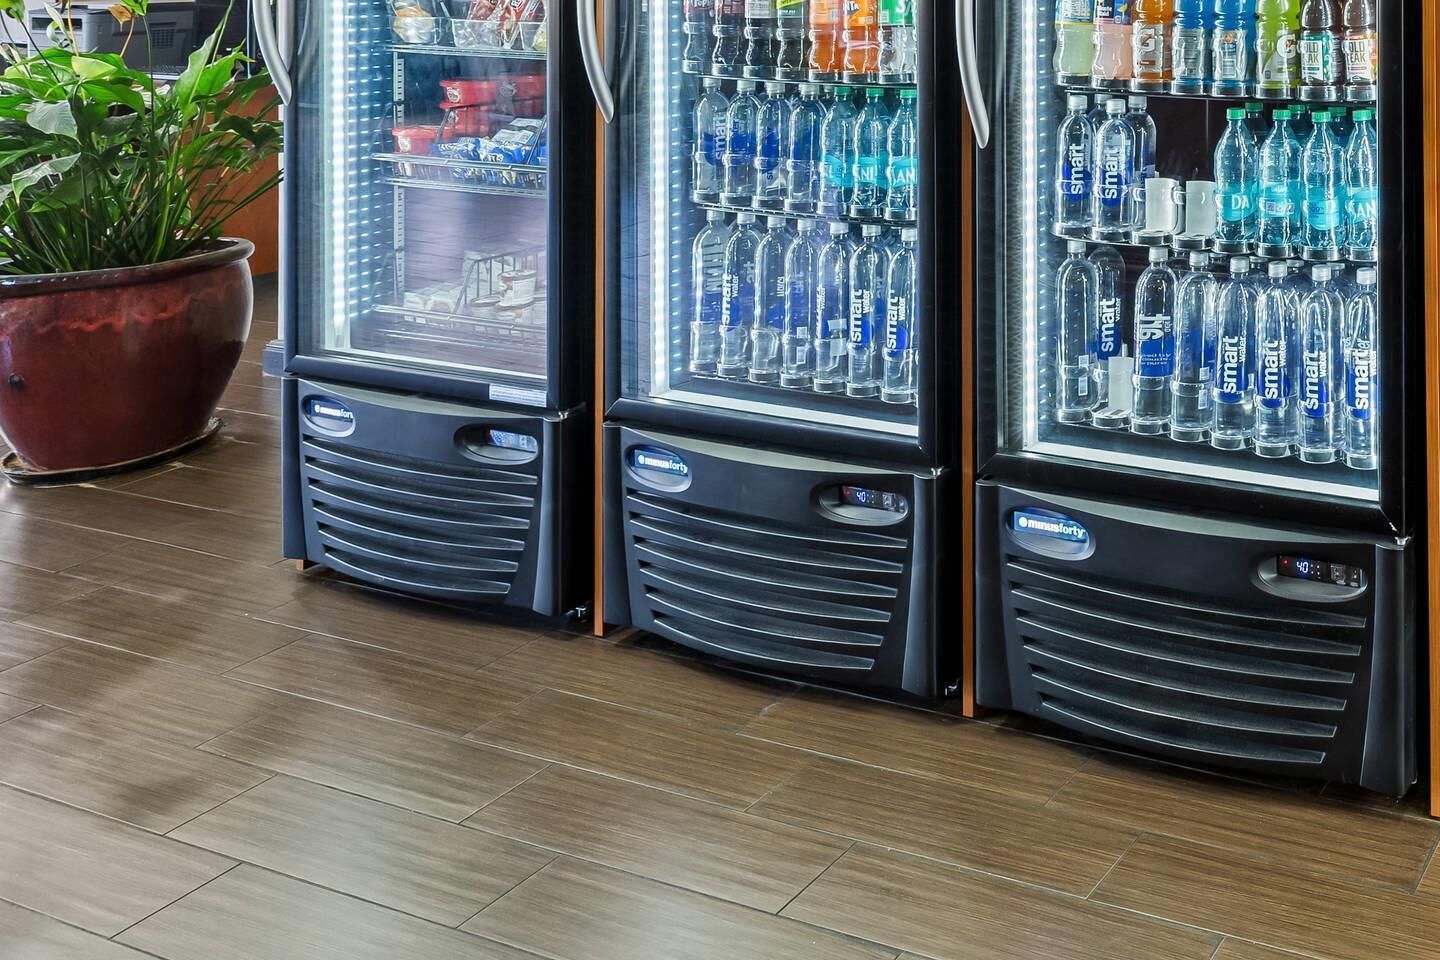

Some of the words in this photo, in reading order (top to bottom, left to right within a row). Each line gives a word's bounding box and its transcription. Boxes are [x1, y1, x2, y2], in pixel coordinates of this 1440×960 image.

[1139, 28, 1156, 50] G
[1277, 33, 1296, 57] G
[1071, 143, 1084, 195] smart
[1105, 147, 1118, 200] smart
[851, 289, 863, 343] smart
[863, 289, 871, 314] water
[887, 289, 899, 351] smart
[1100, 298, 1116, 353] smart
[1223, 335, 1237, 394] smart
[1239, 335, 1247, 363] water
[1263, 339, 1278, 400] smart
[1279, 340, 1287, 367] water
[1304, 351, 1319, 410] smart
[1028, 518, 1086, 538] minusforty
[1296, 560, 1309, 573] 40
